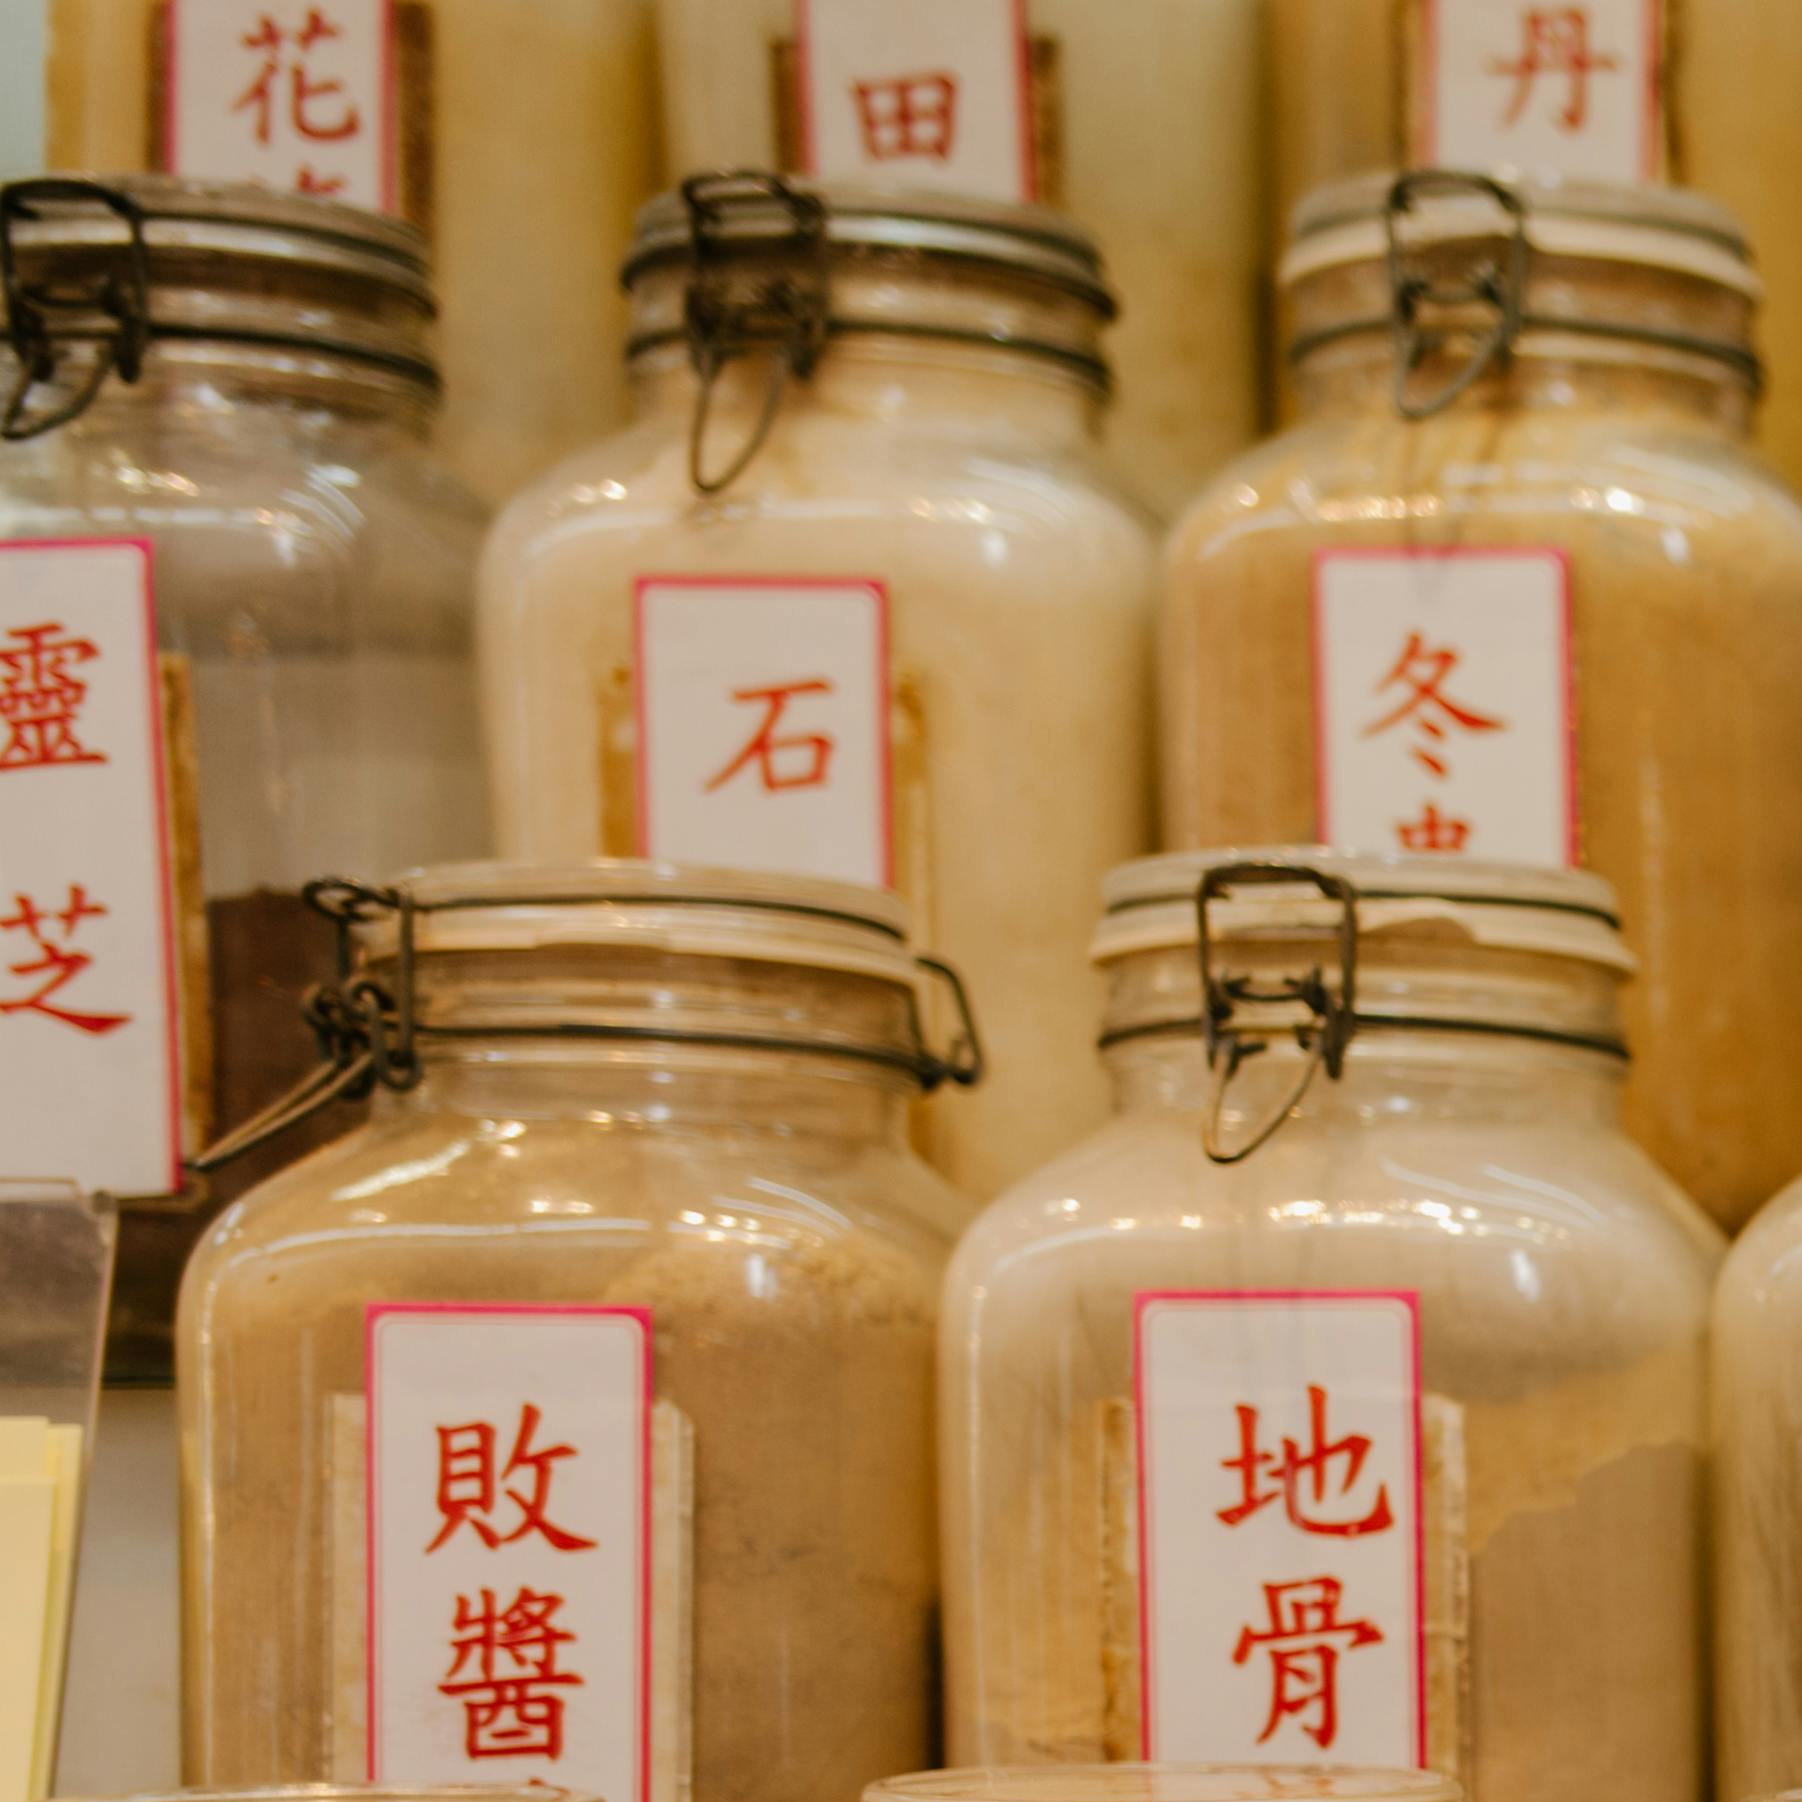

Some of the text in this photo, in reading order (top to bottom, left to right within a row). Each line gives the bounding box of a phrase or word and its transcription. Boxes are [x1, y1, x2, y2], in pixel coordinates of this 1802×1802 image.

[230, 9, 361, 192] 花
[853, 73, 958, 160] 田
[1492, 8, 1617, 132] 丹
[705, 680, 834, 793] 石
[424, 1403, 598, 1788] 敗醬
[1218, 1386, 1393, 1748] 地骨
